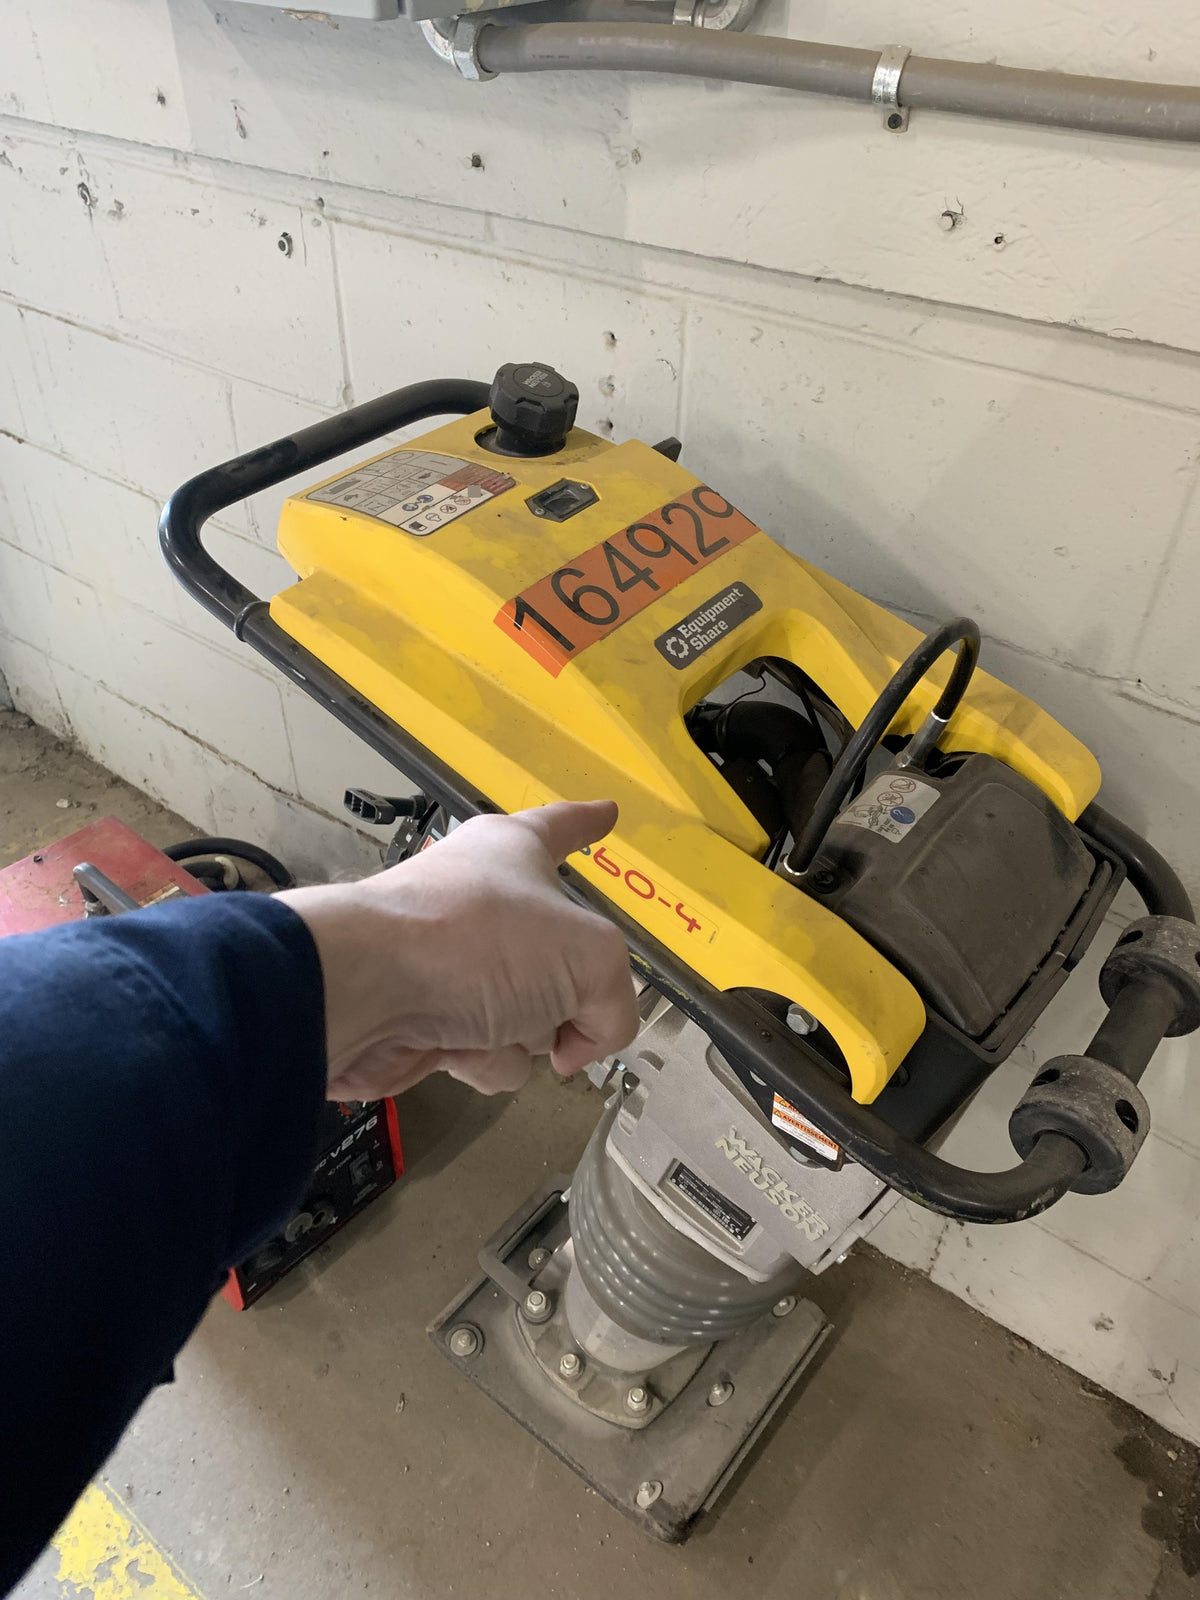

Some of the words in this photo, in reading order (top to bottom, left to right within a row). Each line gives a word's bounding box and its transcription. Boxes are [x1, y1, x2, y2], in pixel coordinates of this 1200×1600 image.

[677, 588, 743, 638] Equipment
[689, 620, 729, 651] Share
[714, 1137, 823, 1242] NEUSON
[728, 1125, 830, 1235] WACKER
